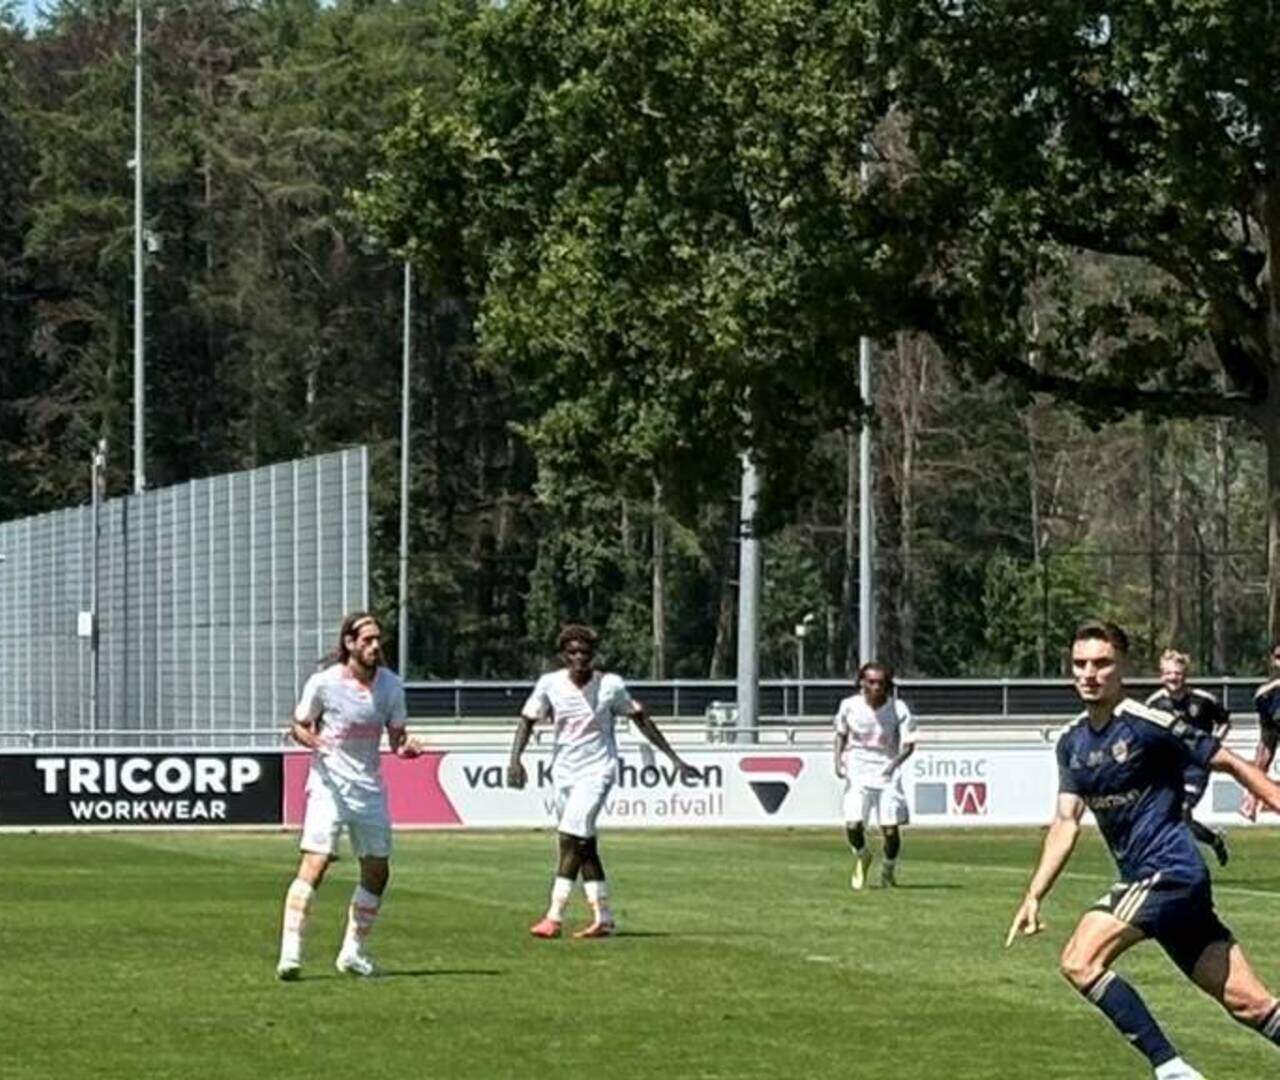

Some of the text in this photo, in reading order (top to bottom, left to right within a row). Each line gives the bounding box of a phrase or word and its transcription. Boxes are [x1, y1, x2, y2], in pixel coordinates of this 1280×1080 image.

[36, 757, 261, 794] TRICORP
[463, 757, 722, 789] va Khoven
[914, 754, 987, 778] simac
[70, 800, 227, 820] WORKWEAR
[605, 799, 647, 816] van
